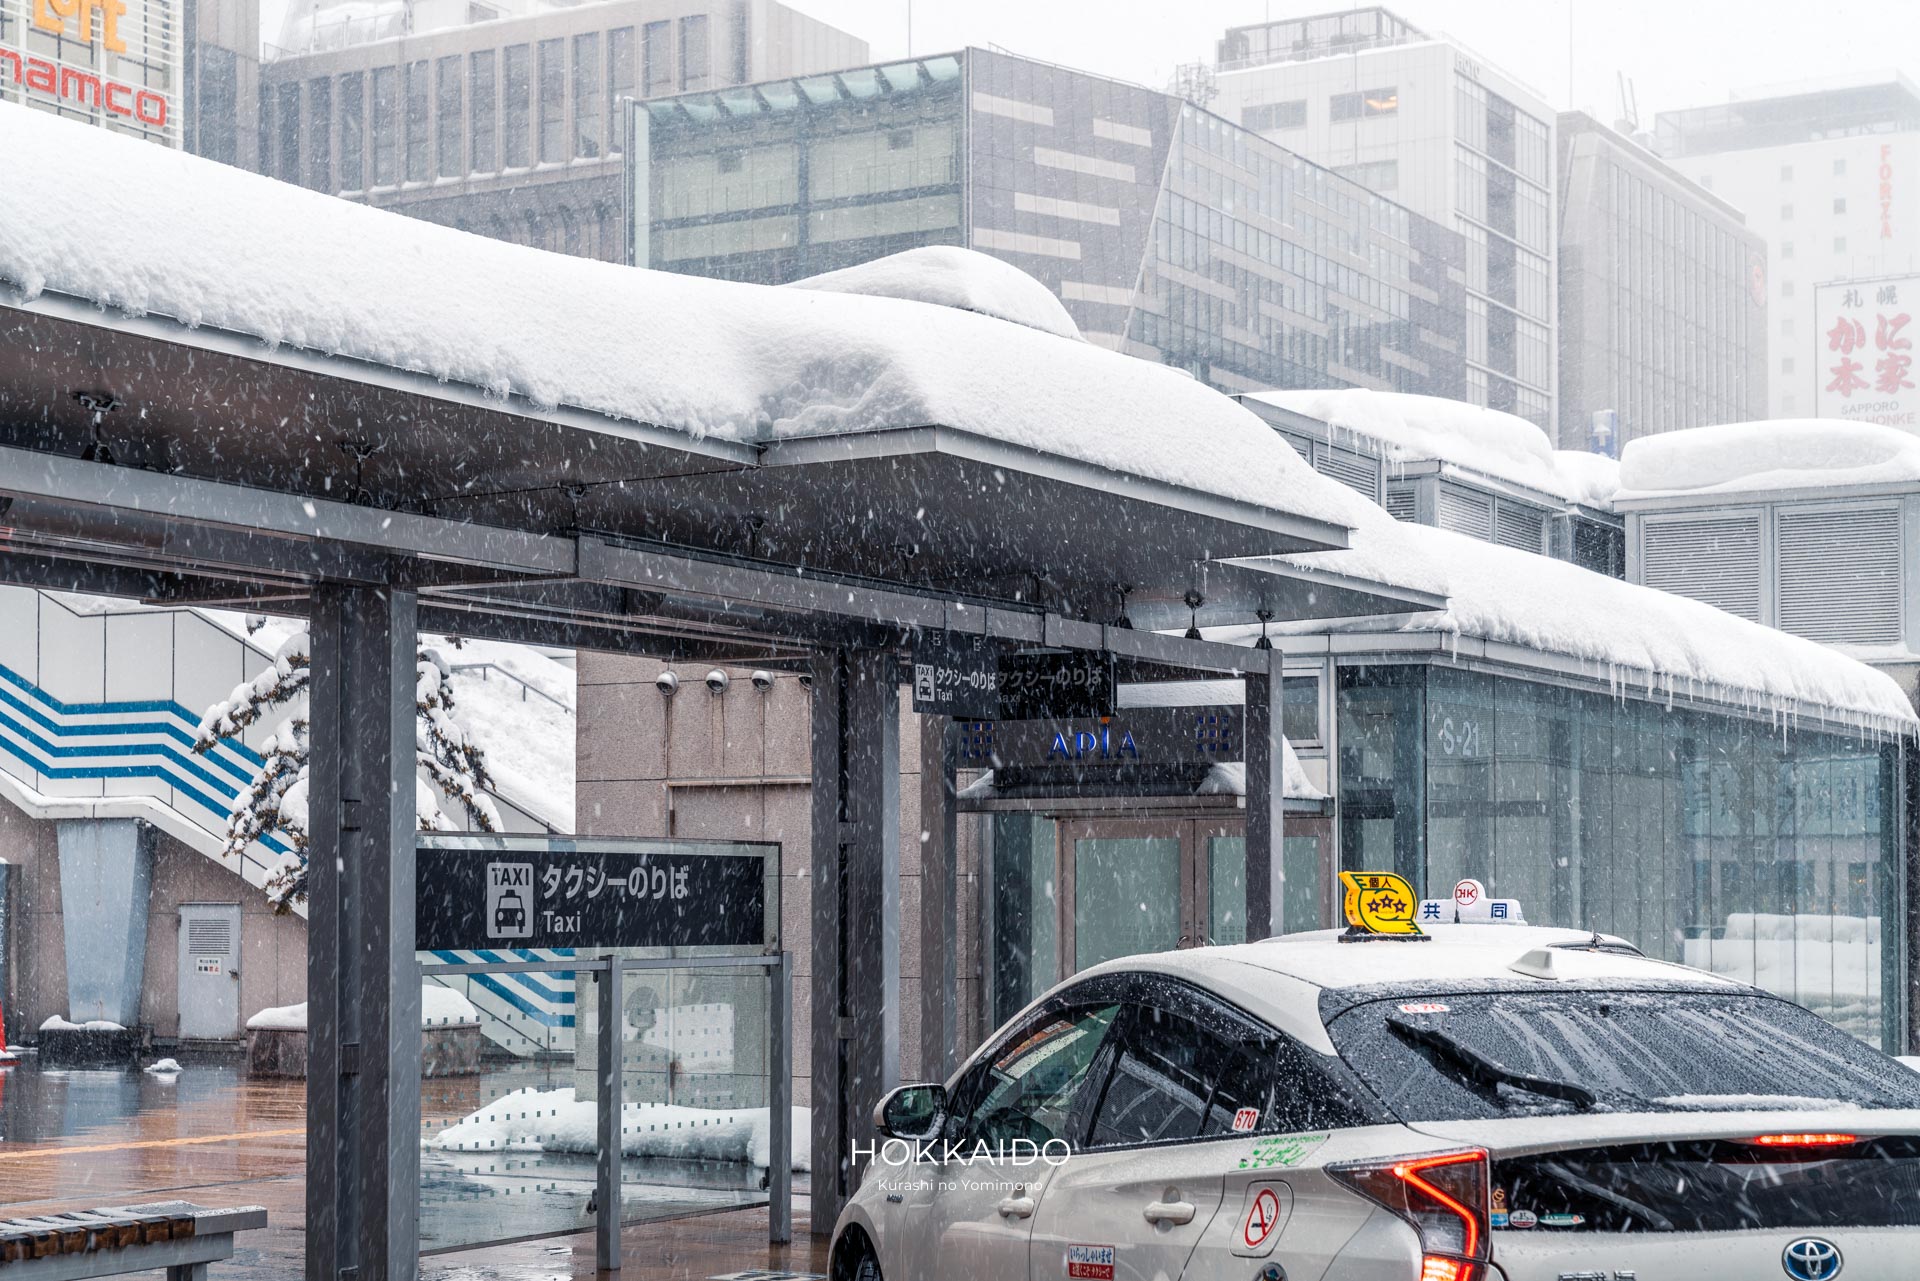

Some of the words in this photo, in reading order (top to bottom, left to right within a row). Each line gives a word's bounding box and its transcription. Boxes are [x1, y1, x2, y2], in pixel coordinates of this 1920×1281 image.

[0, 47, 167, 127] namco
[1826, 313, 1913, 355] かに
[1825, 352, 1916, 398] 本家
[1841, 400, 1899, 415] SAPPORO
[936, 667, 997, 690] タクシーのりば
[936, 688, 953, 702] Taxi
[1048, 719, 1141, 760] APIA
[1443, 717, 1479, 757] S-21
[491, 866, 530, 887] TAXI
[542, 864, 690, 900] タクシーのりば
[1369, 876, 1392, 888] 個人
[543, 911, 582, 934] Taxi
[1235, 1110, 1257, 1129] 670
